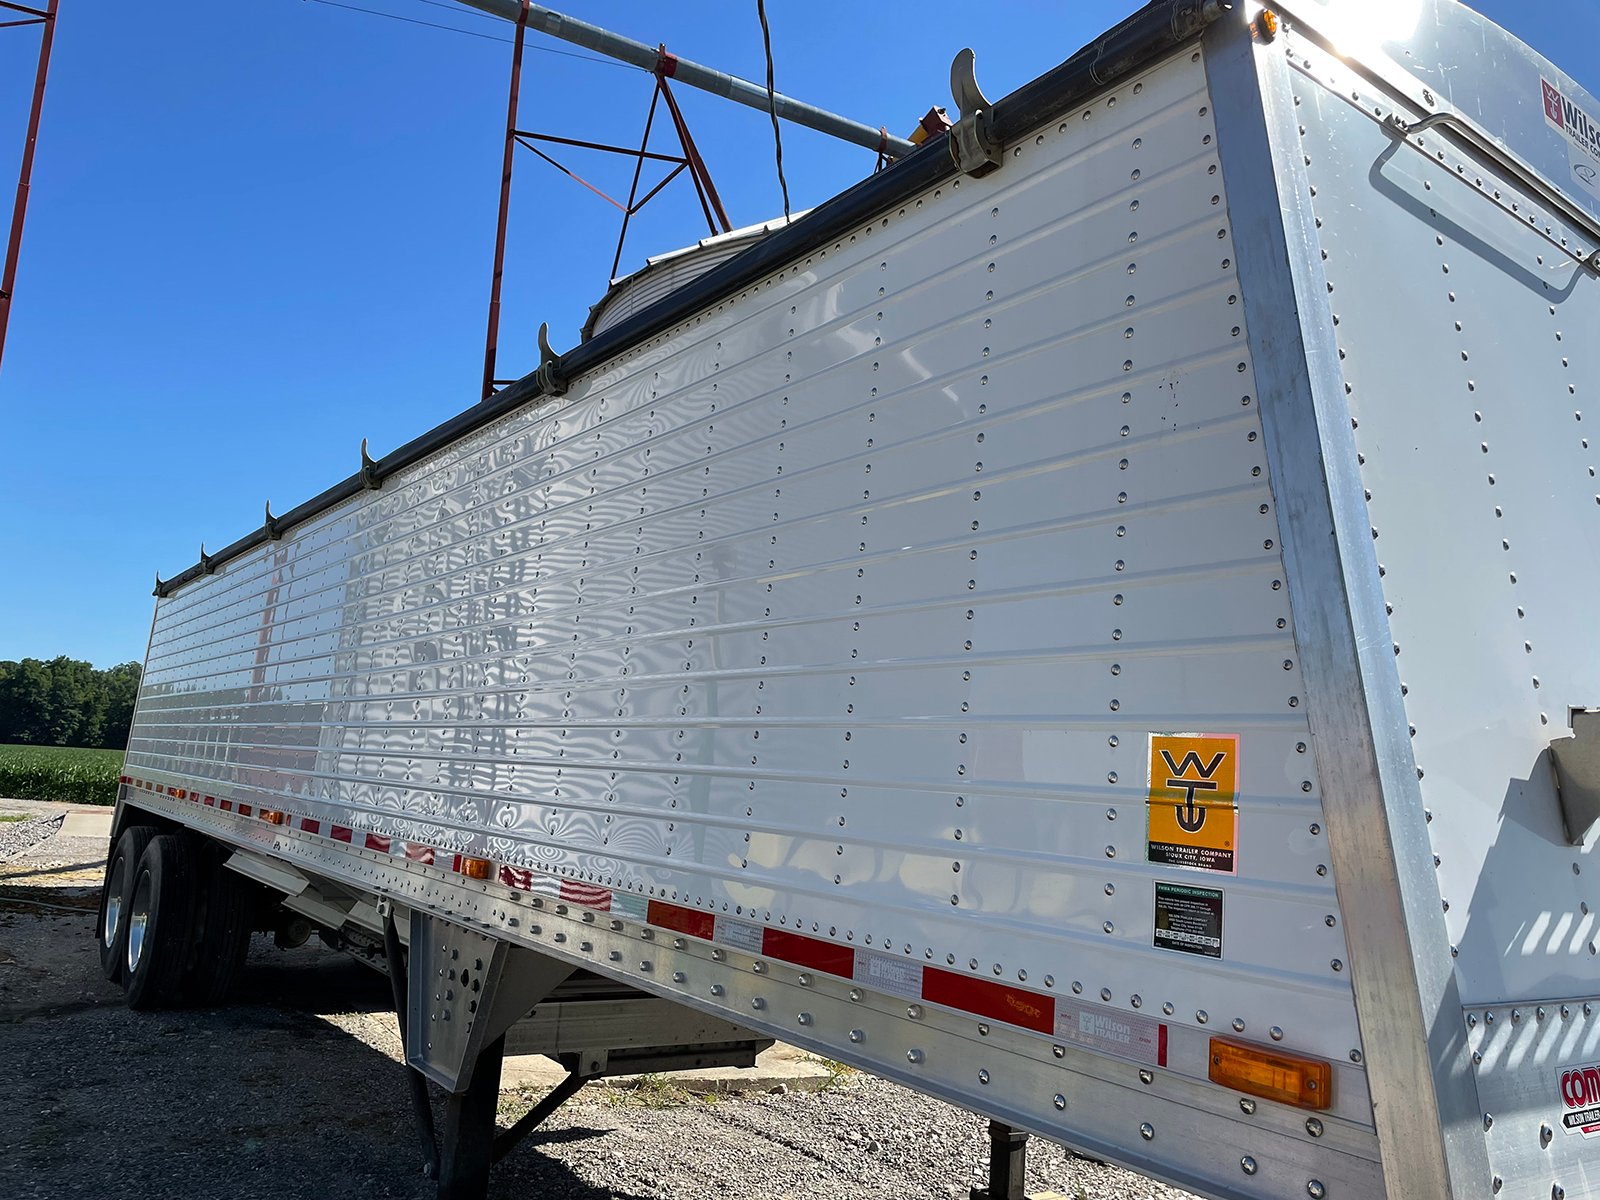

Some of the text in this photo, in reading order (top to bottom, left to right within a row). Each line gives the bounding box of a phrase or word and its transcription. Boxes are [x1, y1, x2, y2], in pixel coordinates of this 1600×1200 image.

[1150, 844, 1232, 859] WILSON TRAILER COMPANY
[1165, 852, 1183, 860] SIOUX
[1199, 855, 1216, 864] IOWA
[1171, 886, 1192, 894] PERIODIC
[1094, 1014, 1130, 1035] Wilson
[1095, 1028, 1131, 1044] TRAILER
[1561, 1066, 1600, 1109] COM
